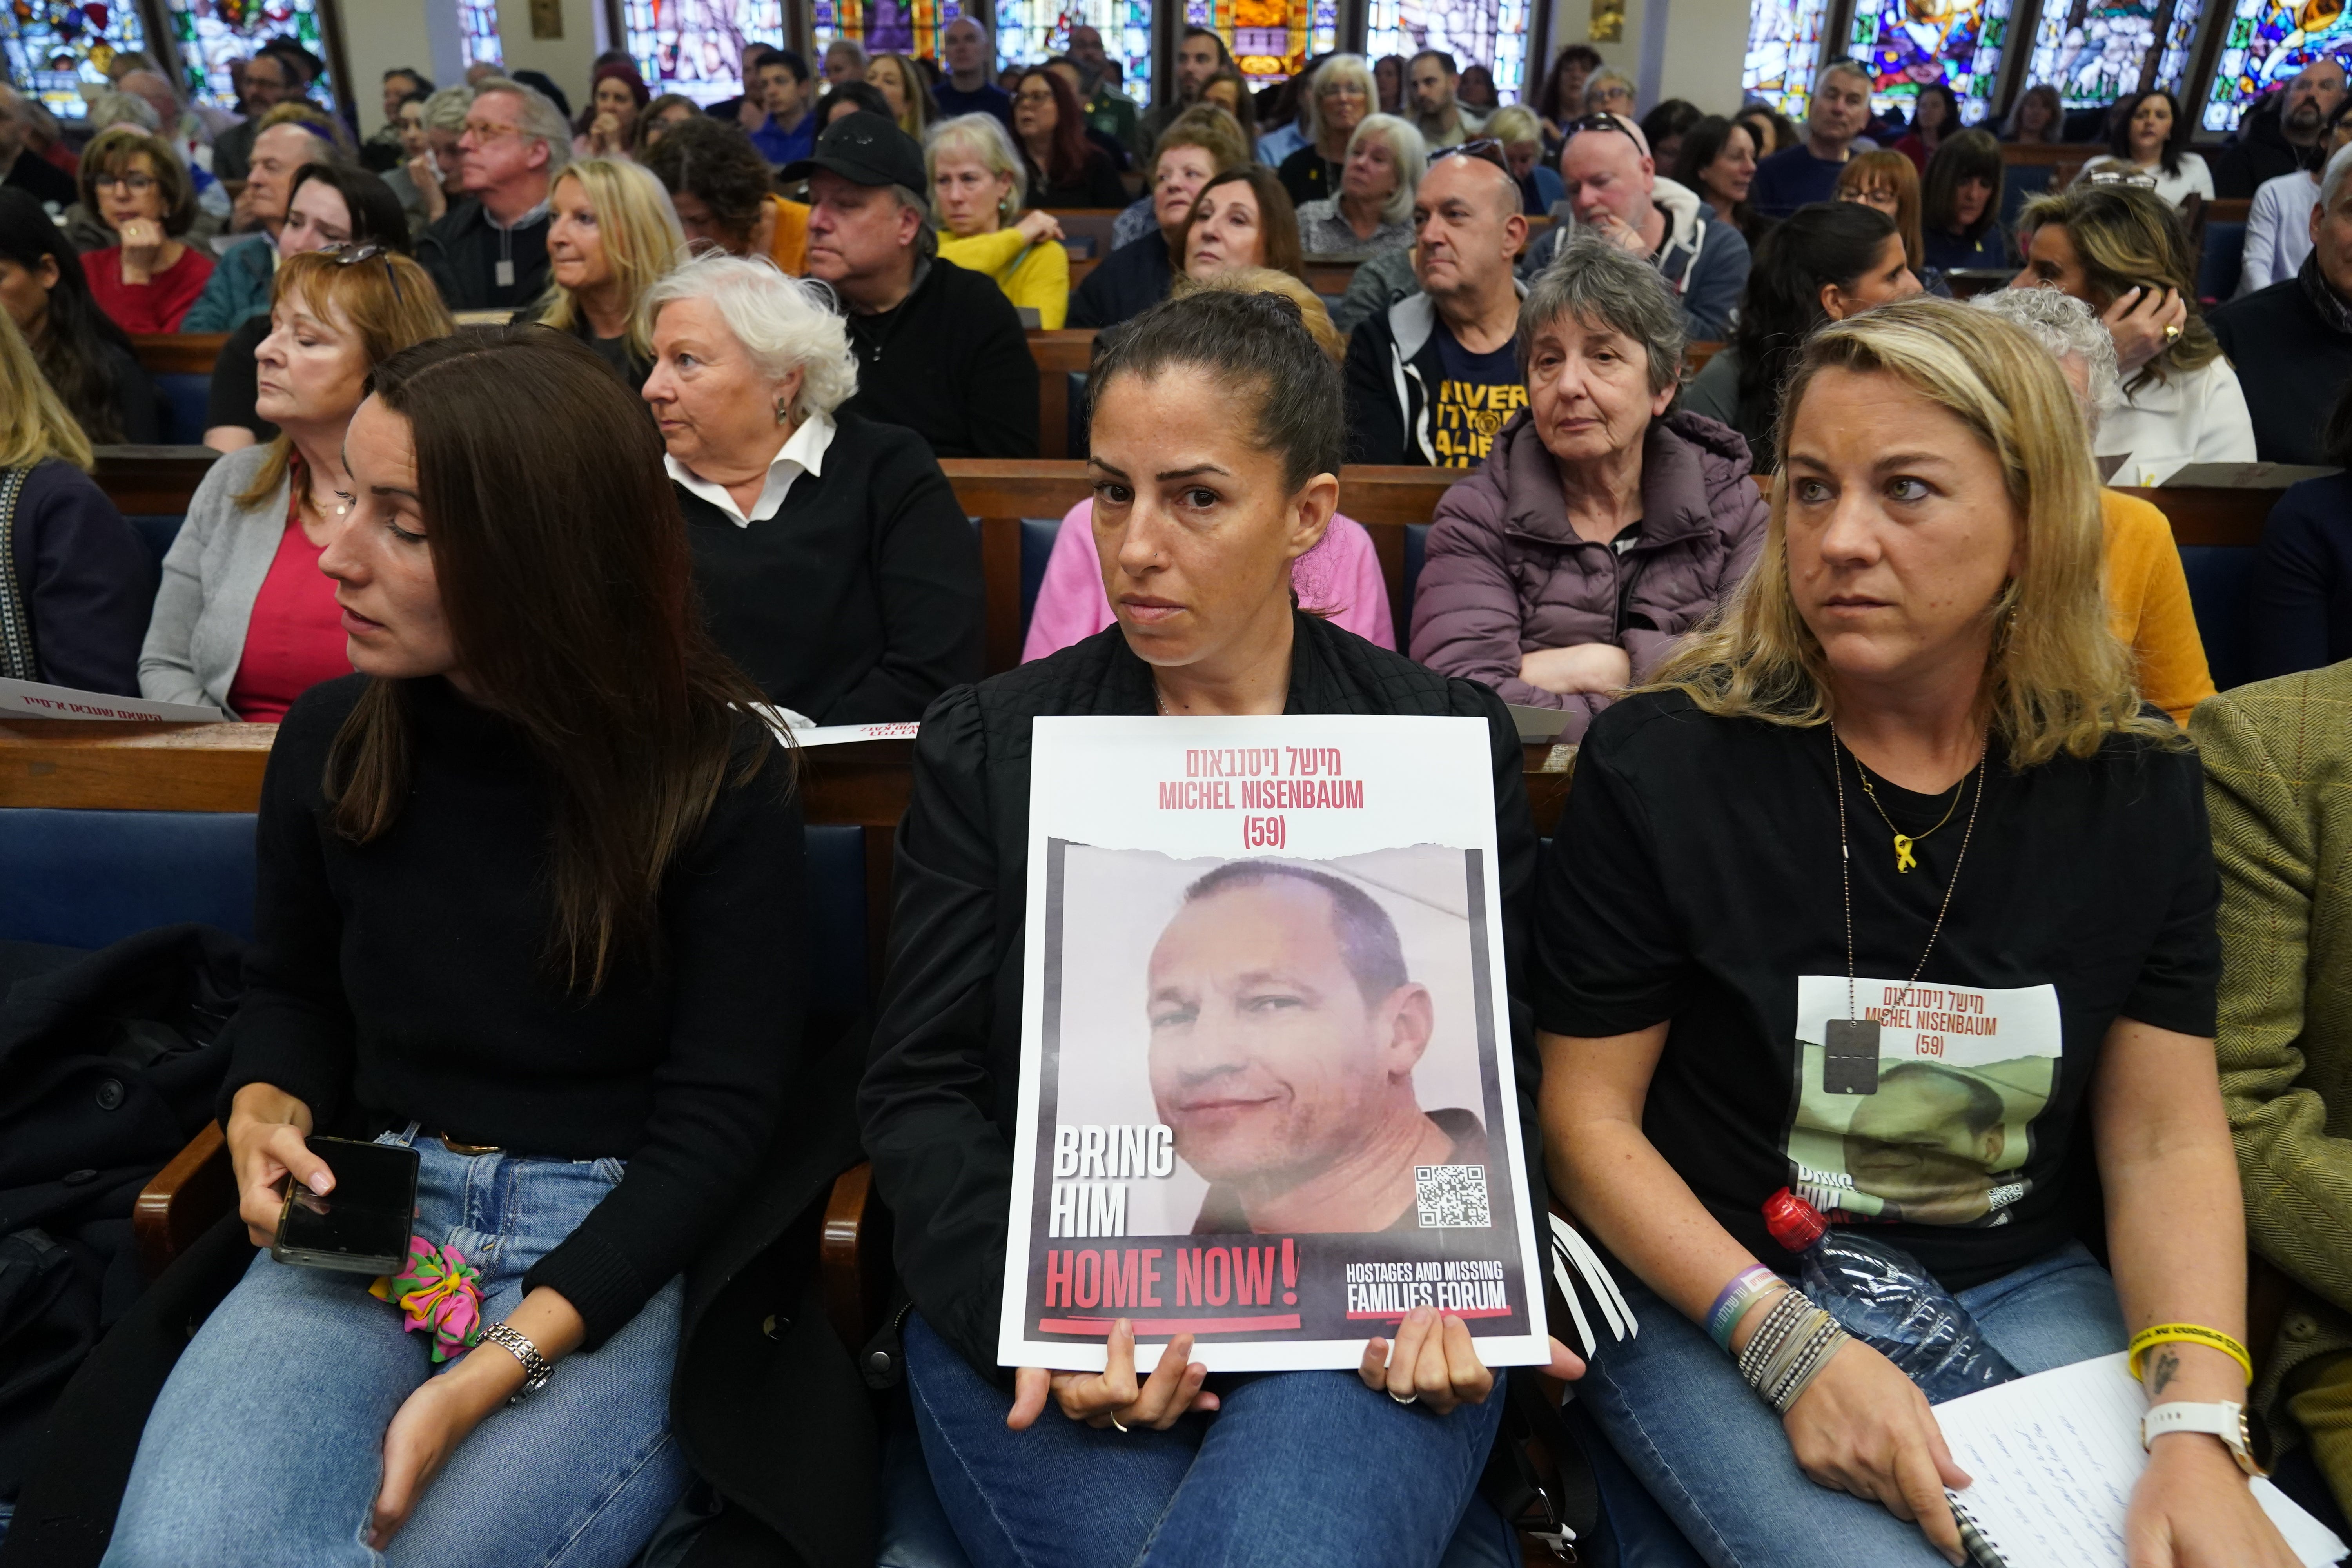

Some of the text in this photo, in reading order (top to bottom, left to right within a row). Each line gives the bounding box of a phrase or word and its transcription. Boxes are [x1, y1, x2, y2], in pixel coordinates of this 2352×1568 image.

[1186, 746, 1341, 777] מישל ניסנבאום
[1159, 780, 1363, 809] MICHEL NISENBAUM
[1244, 815, 1285, 849] (59)
[1883, 987, 1984, 1014] מישל ניסנבאום
[1865, 1007, 1997, 1036] MICHEL NISENBAUM
[1916, 1033, 1944, 1058] (59)
[1052, 1123, 1174, 1177] BRING
[1049, 1183, 1126, 1238] HIM
[1045, 1238, 1301, 1308] HOME NOW!
[1346, 1260, 1503, 1283] HOSTAGES AND MISSING
[1347, 1280, 1507, 1313] FAMILIES FORUM
